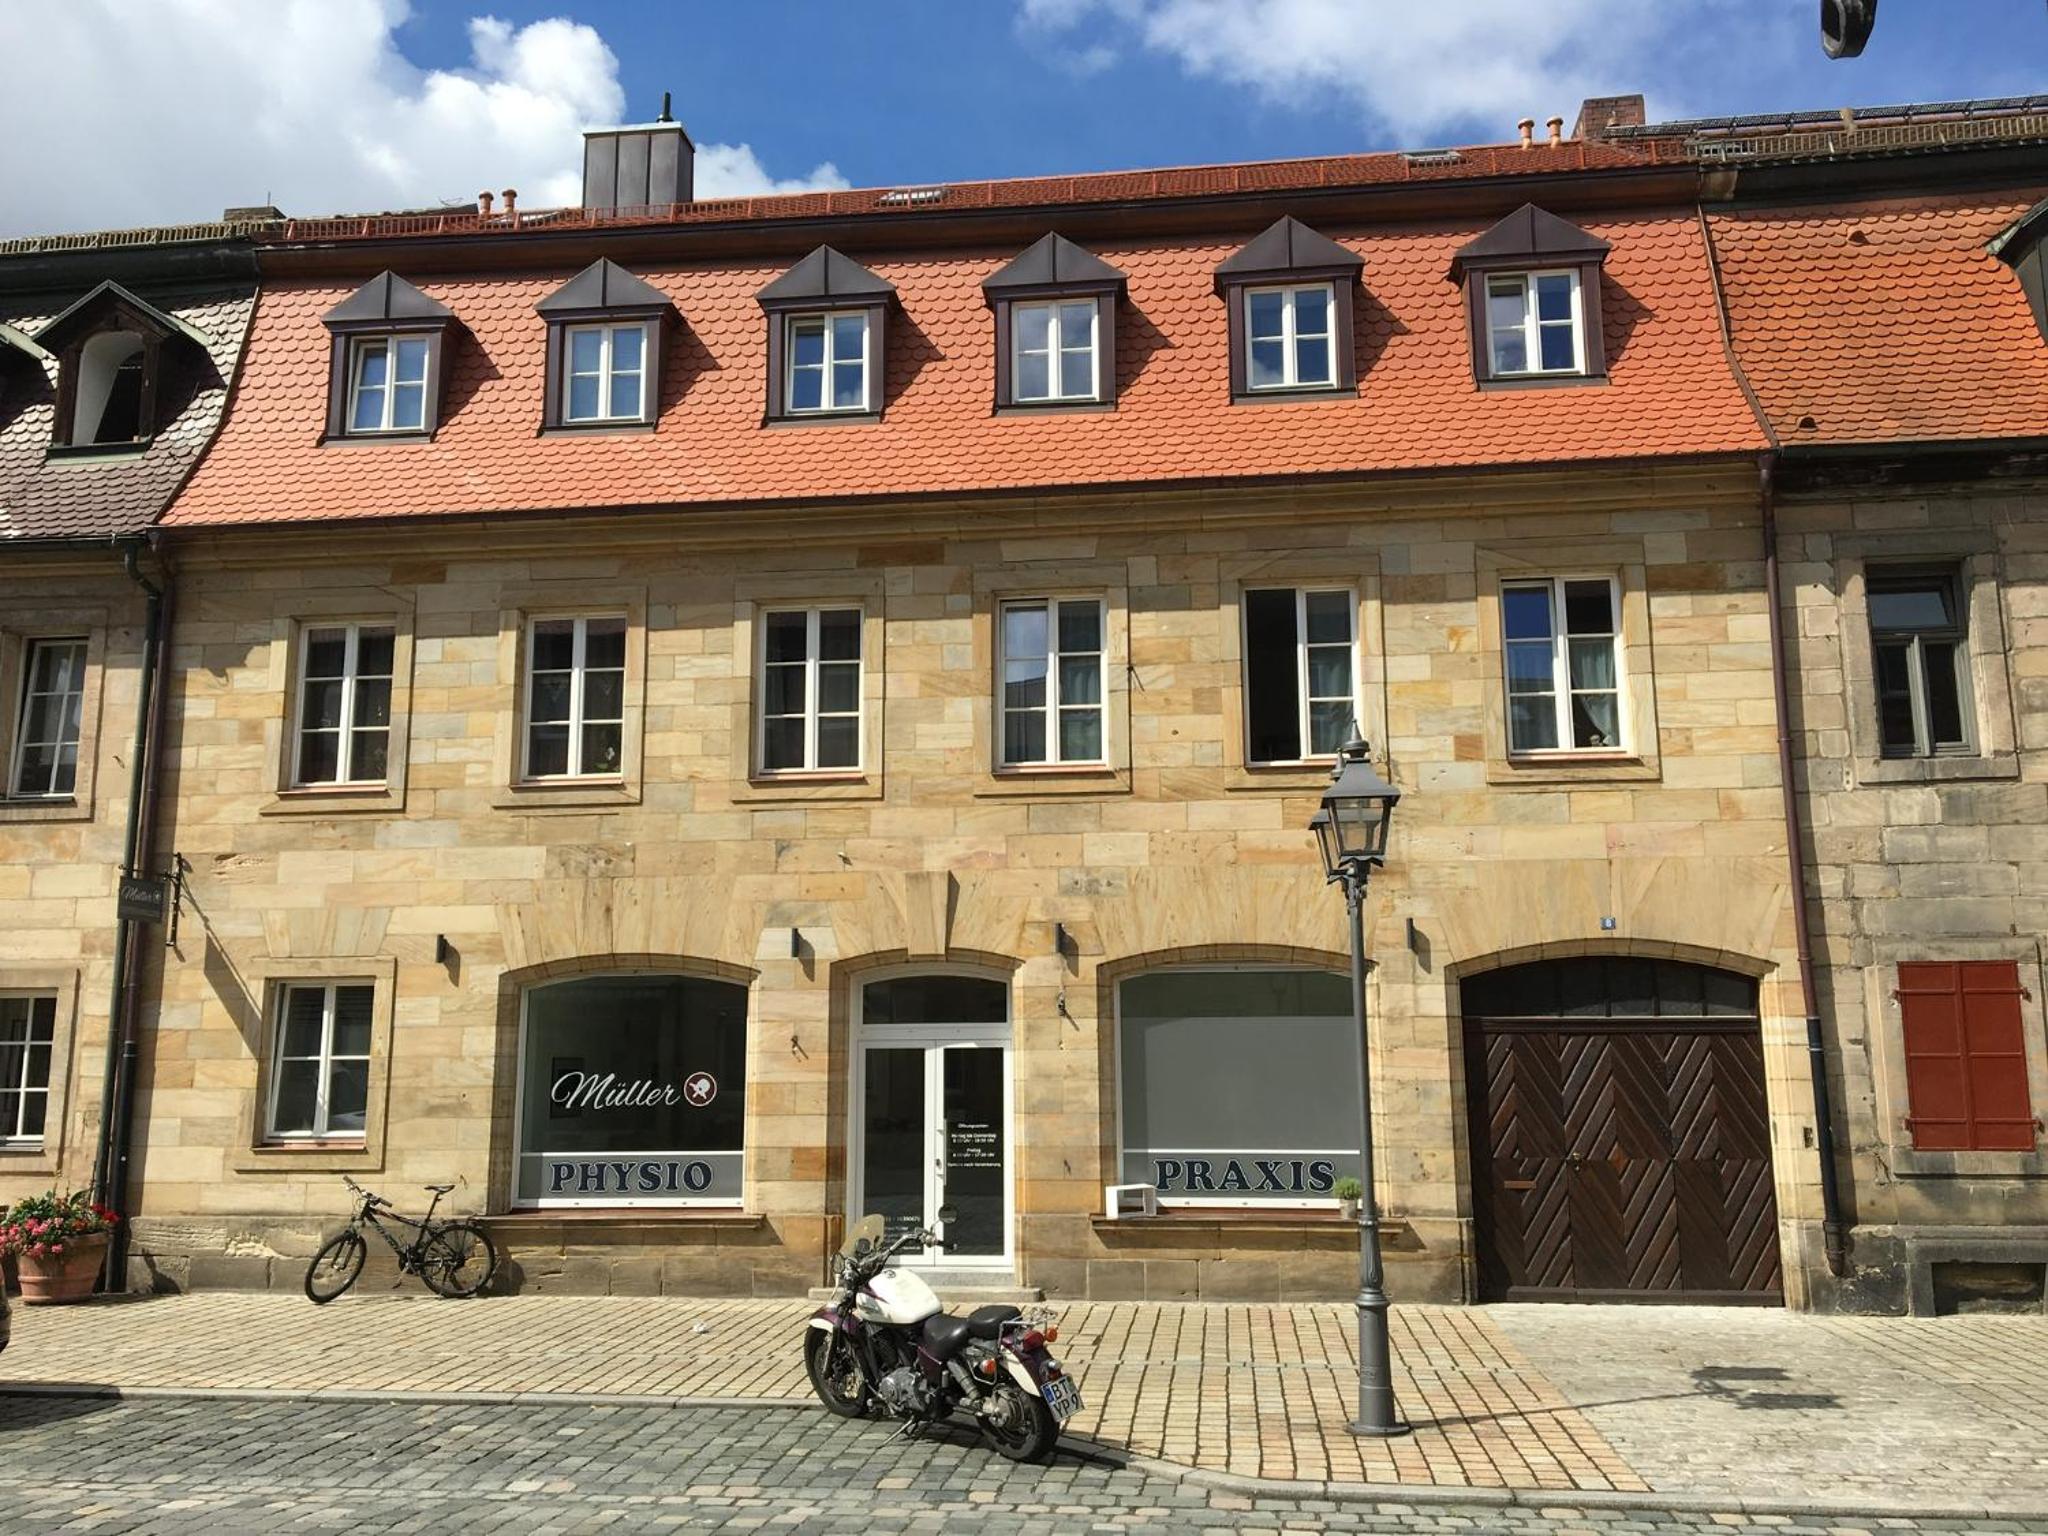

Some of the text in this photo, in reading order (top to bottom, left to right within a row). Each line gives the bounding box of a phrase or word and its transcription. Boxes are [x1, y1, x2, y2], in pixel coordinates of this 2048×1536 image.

[551, 1071, 681, 1109] Müller
[549, 1160, 713, 1193] PHYSIO
[1154, 1158, 1336, 1192] PRAXIS
[1051, 1379, 1069, 1400] BT
[1053, 1393, 1079, 1418] YP 9
